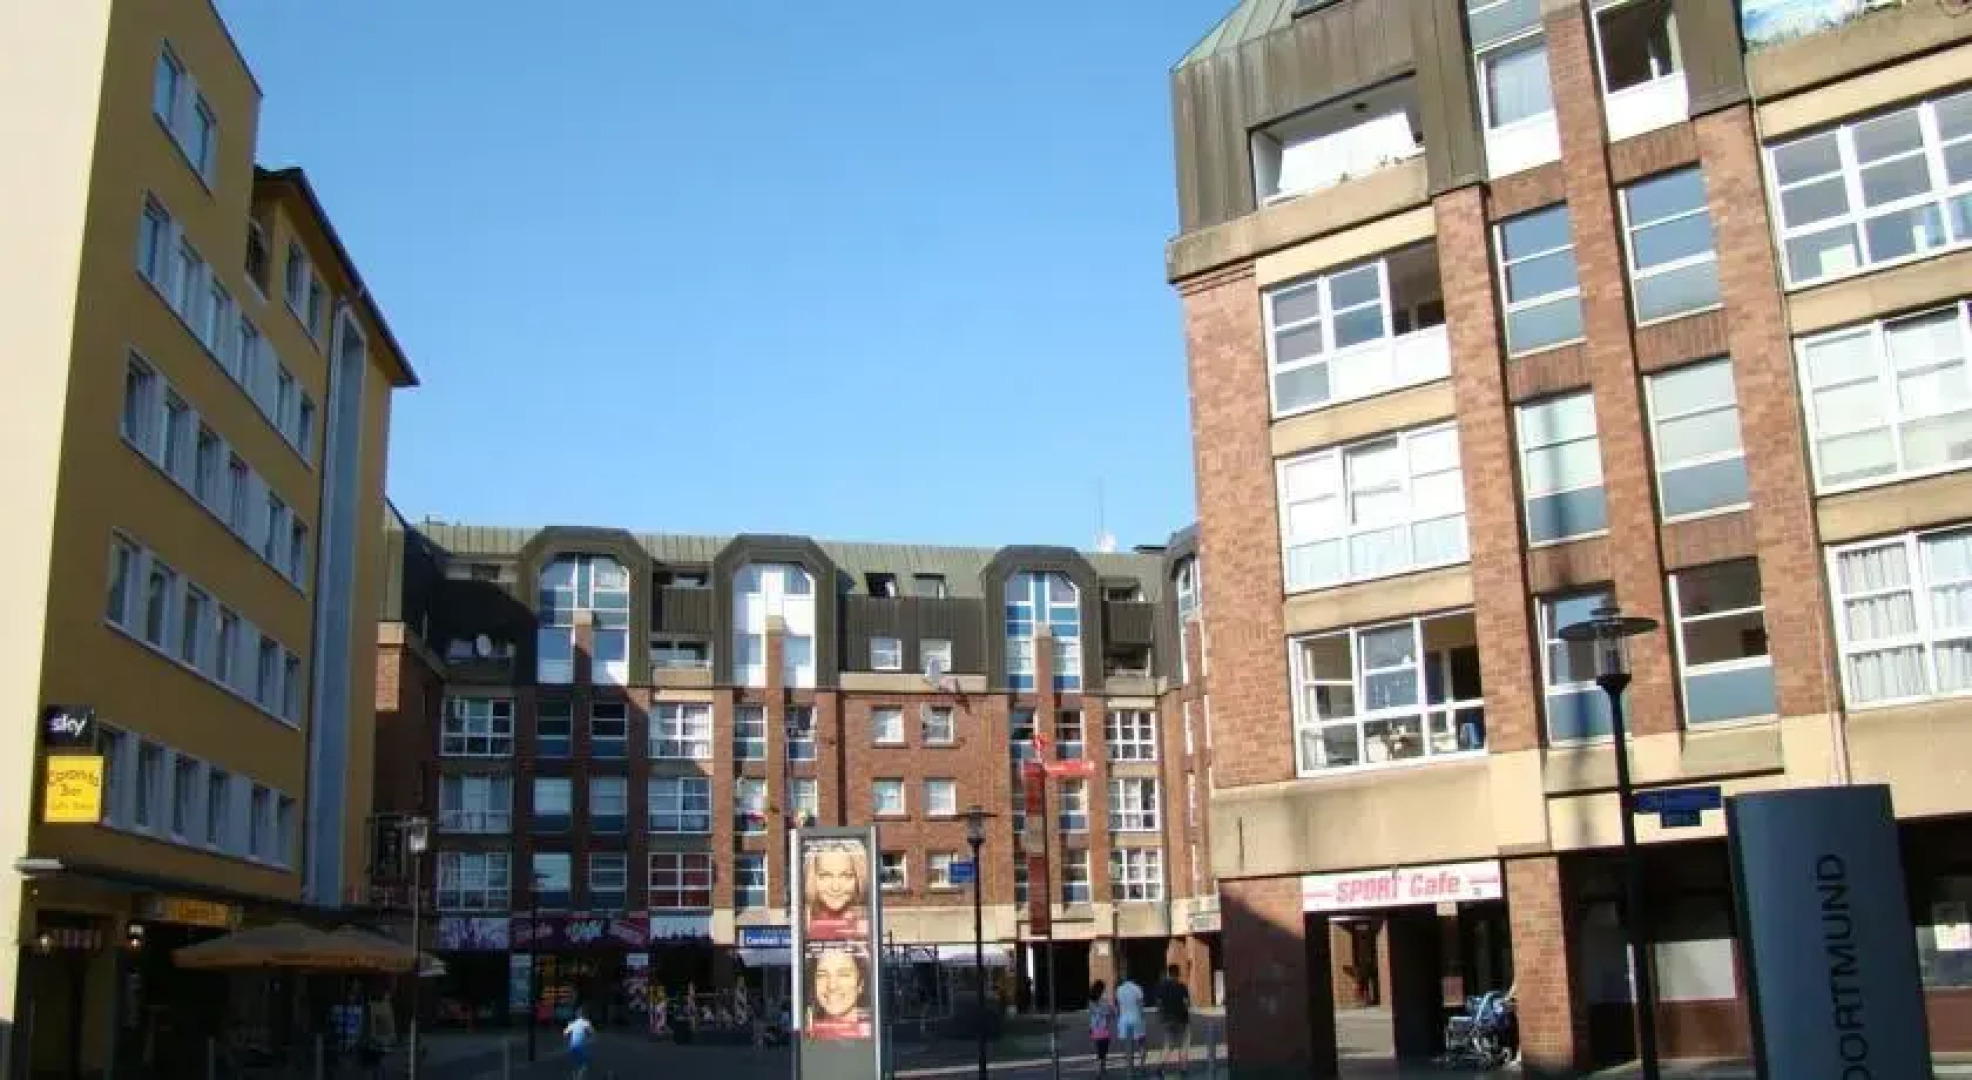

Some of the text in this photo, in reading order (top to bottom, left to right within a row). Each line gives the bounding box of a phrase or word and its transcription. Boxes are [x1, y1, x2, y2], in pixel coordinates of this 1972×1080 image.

[51, 713, 88, 737] sky
[1335, 875, 1401, 903] SPORT
[1816, 854, 1872, 1080] DORTMUND
